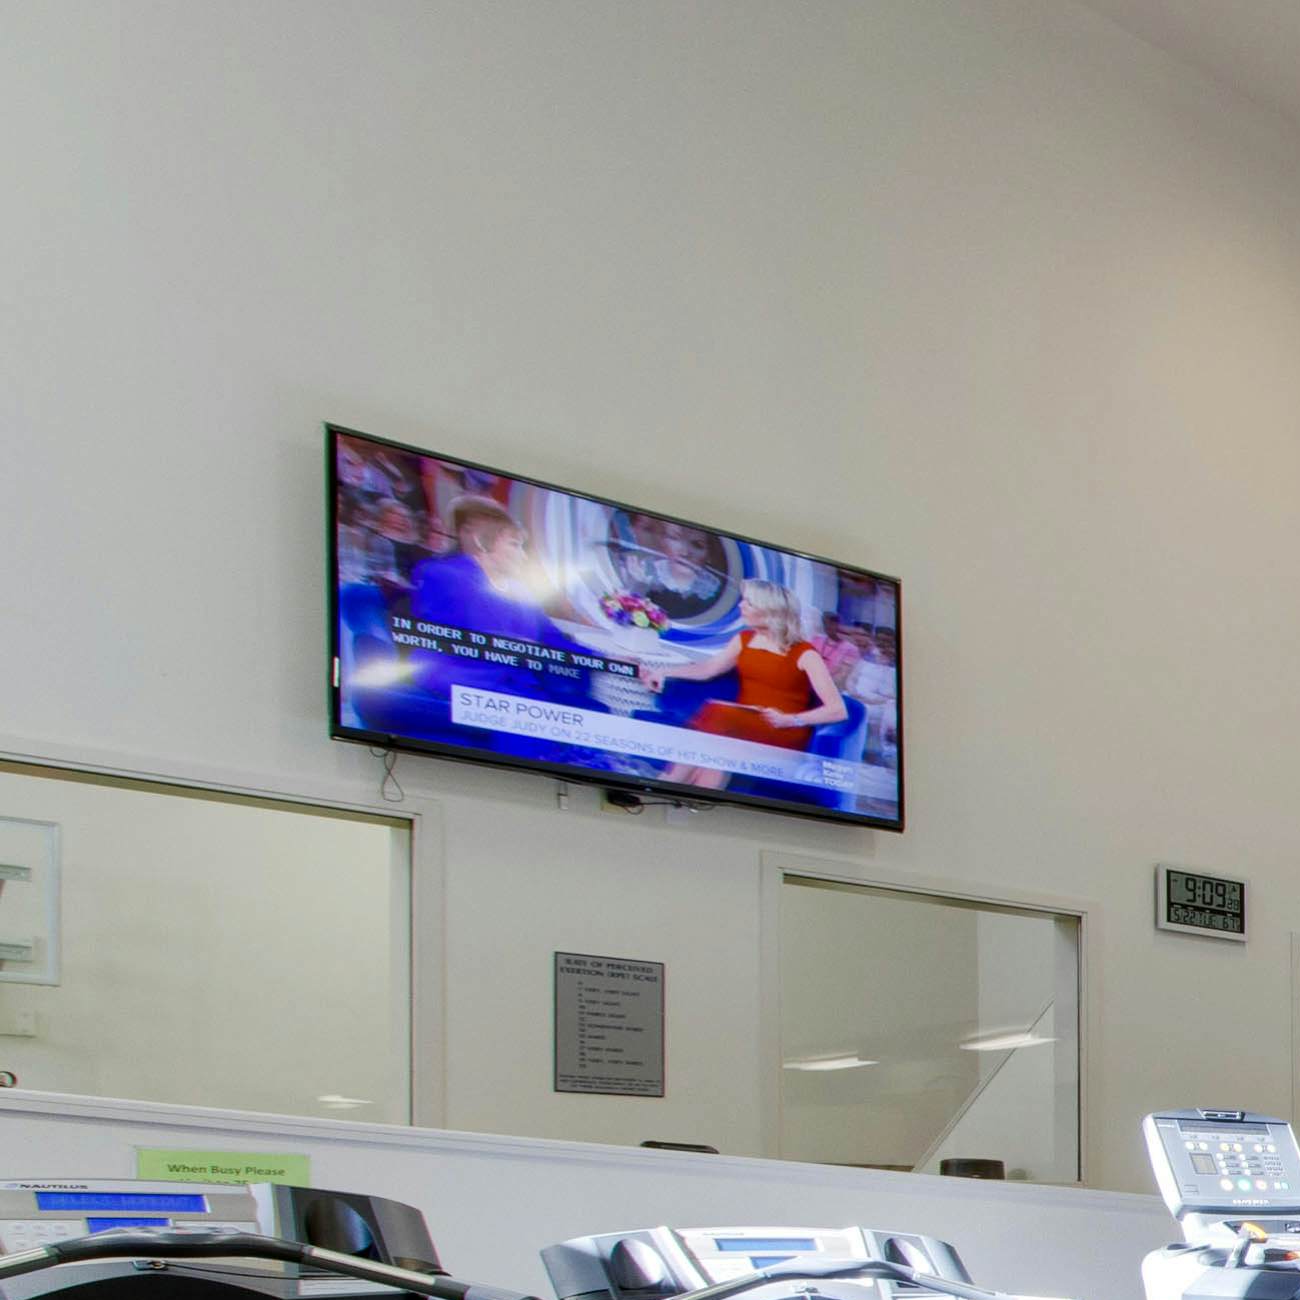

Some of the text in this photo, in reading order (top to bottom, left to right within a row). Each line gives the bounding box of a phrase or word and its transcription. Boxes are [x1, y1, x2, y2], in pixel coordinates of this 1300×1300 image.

[392, 616, 635, 677] IN ORDER TO NEGOTIATE YOUR OWN
[452, 643, 478, 659] YOU
[485, 650, 518, 667] HAVE
[527, 659, 542, 671] TO
[549, 662, 581, 680] MAKE
[460, 691, 584, 727] STAR POWER
[461, 710, 505, 729] JUDGE
[511, 718, 546, 735] JUDY
[550, 725, 570, 740] ON
[575, 729, 591, 742] 22
[594, 733, 653, 755] SEASONS
[678, 748, 695, 761] HIT
[699, 751, 738, 769] SHOW
[750, 762, 785, 777] MORE
[1185, 877, 1226, 908] 9:09
[167, 1163, 285, 1177] When Busy Please
